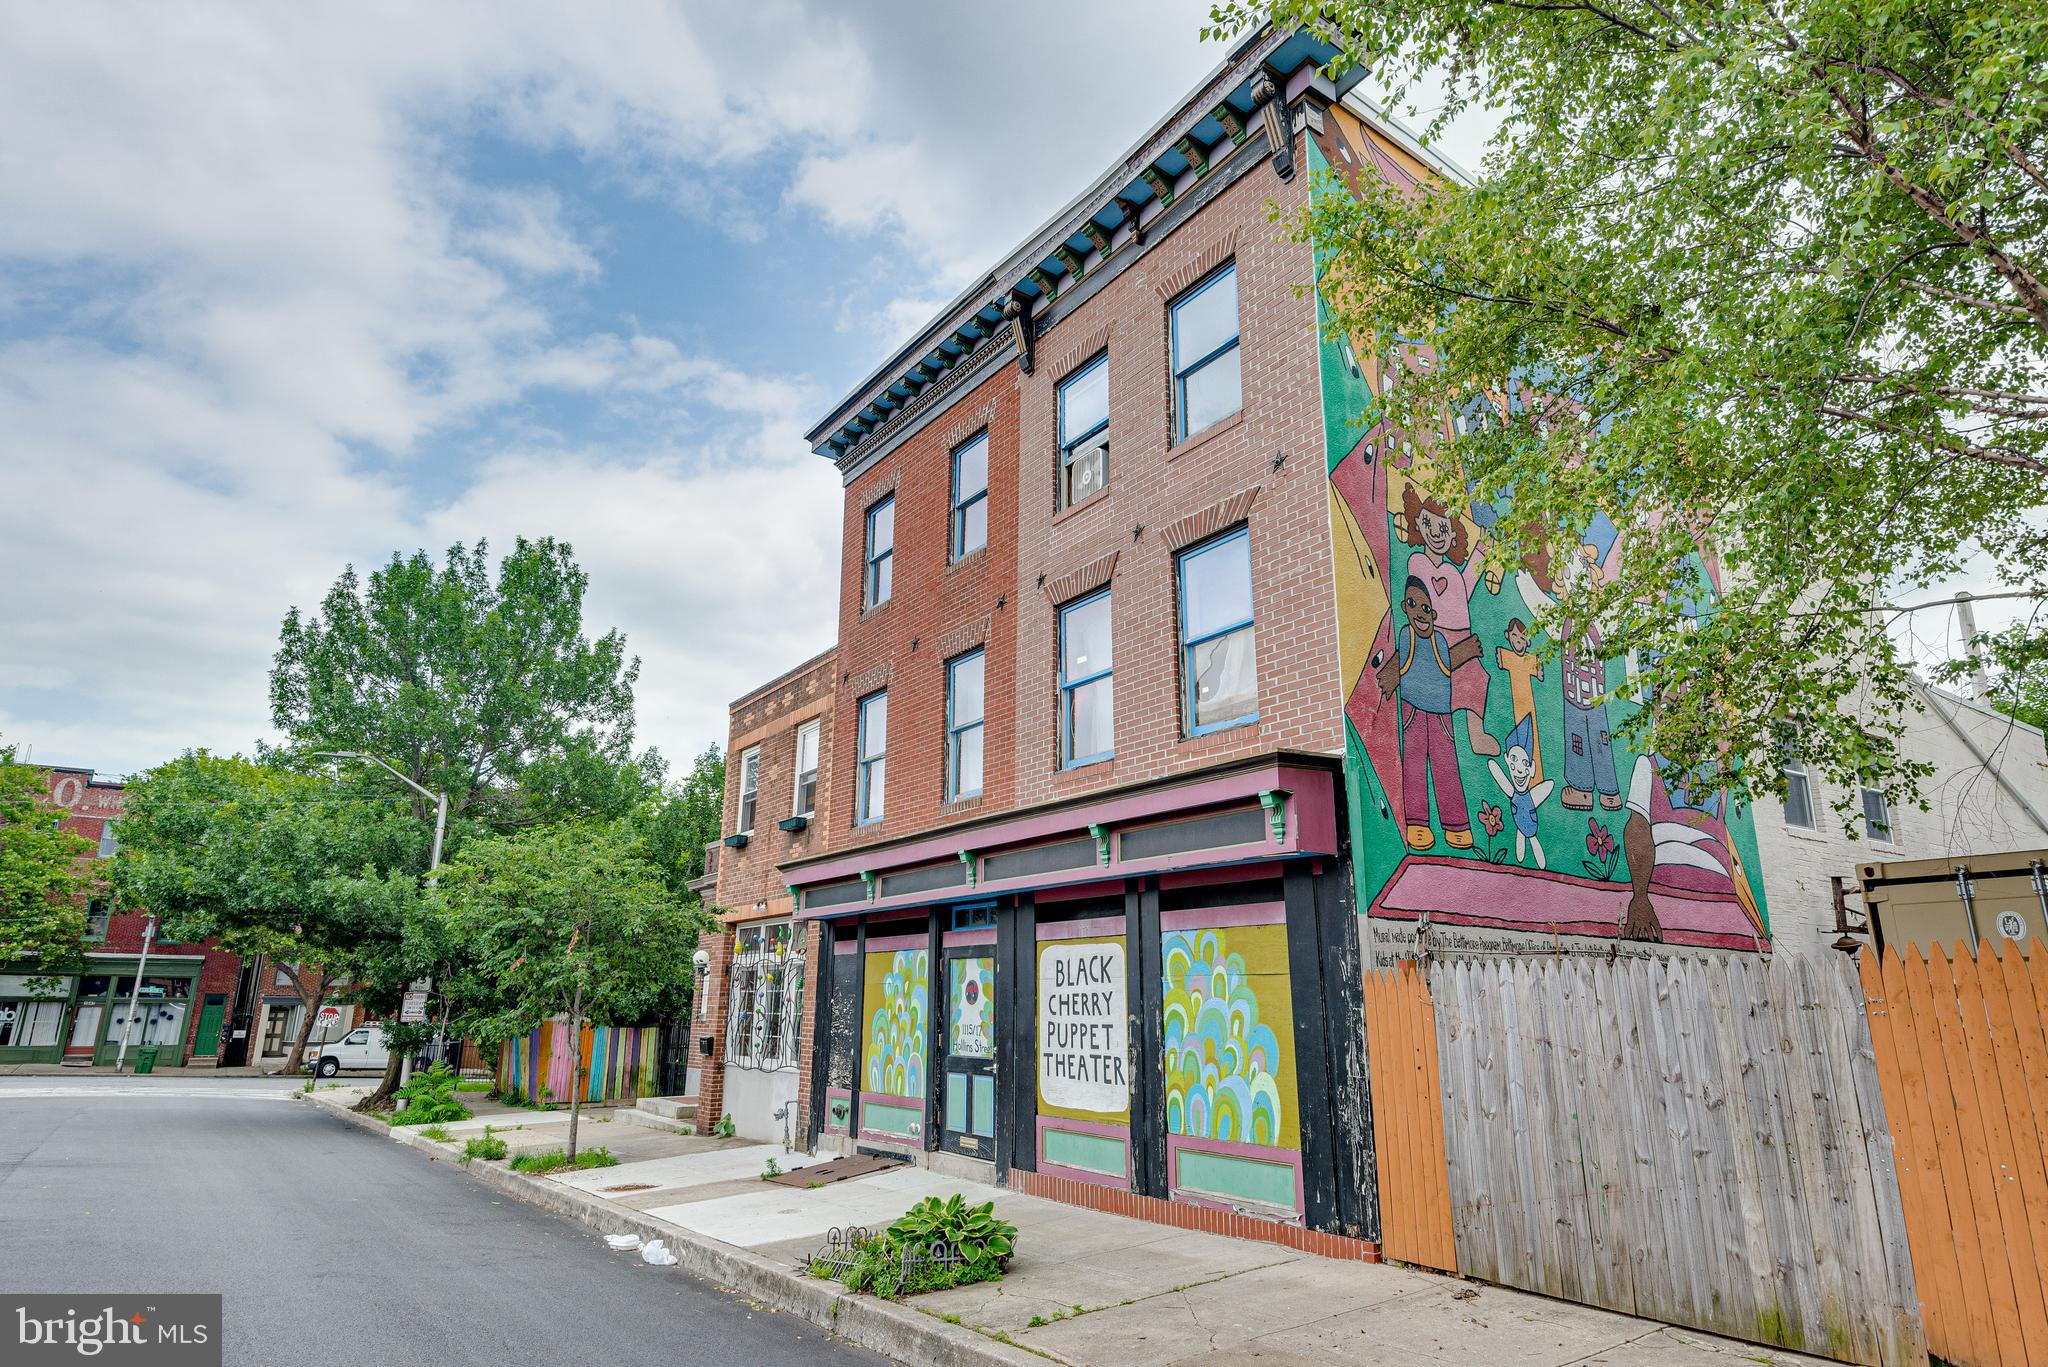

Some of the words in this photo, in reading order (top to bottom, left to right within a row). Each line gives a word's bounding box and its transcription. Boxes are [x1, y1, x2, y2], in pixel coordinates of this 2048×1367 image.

[1373, 927, 1390, 943] Mural
[1391, 928, 1406, 943] made
[1376, 951, 1388, 967] Kids
[1055, 956, 1113, 987] BLACK
[1048, 991, 1113, 1016] CHERRY
[319, 1012, 339, 1020] STOP
[962, 1024, 982, 1036] 1115/17
[1047, 1021, 1114, 1050] PUPPET
[953, 1039, 973, 1053] Hollins
[1043, 1053, 1126, 1086] THEATER
